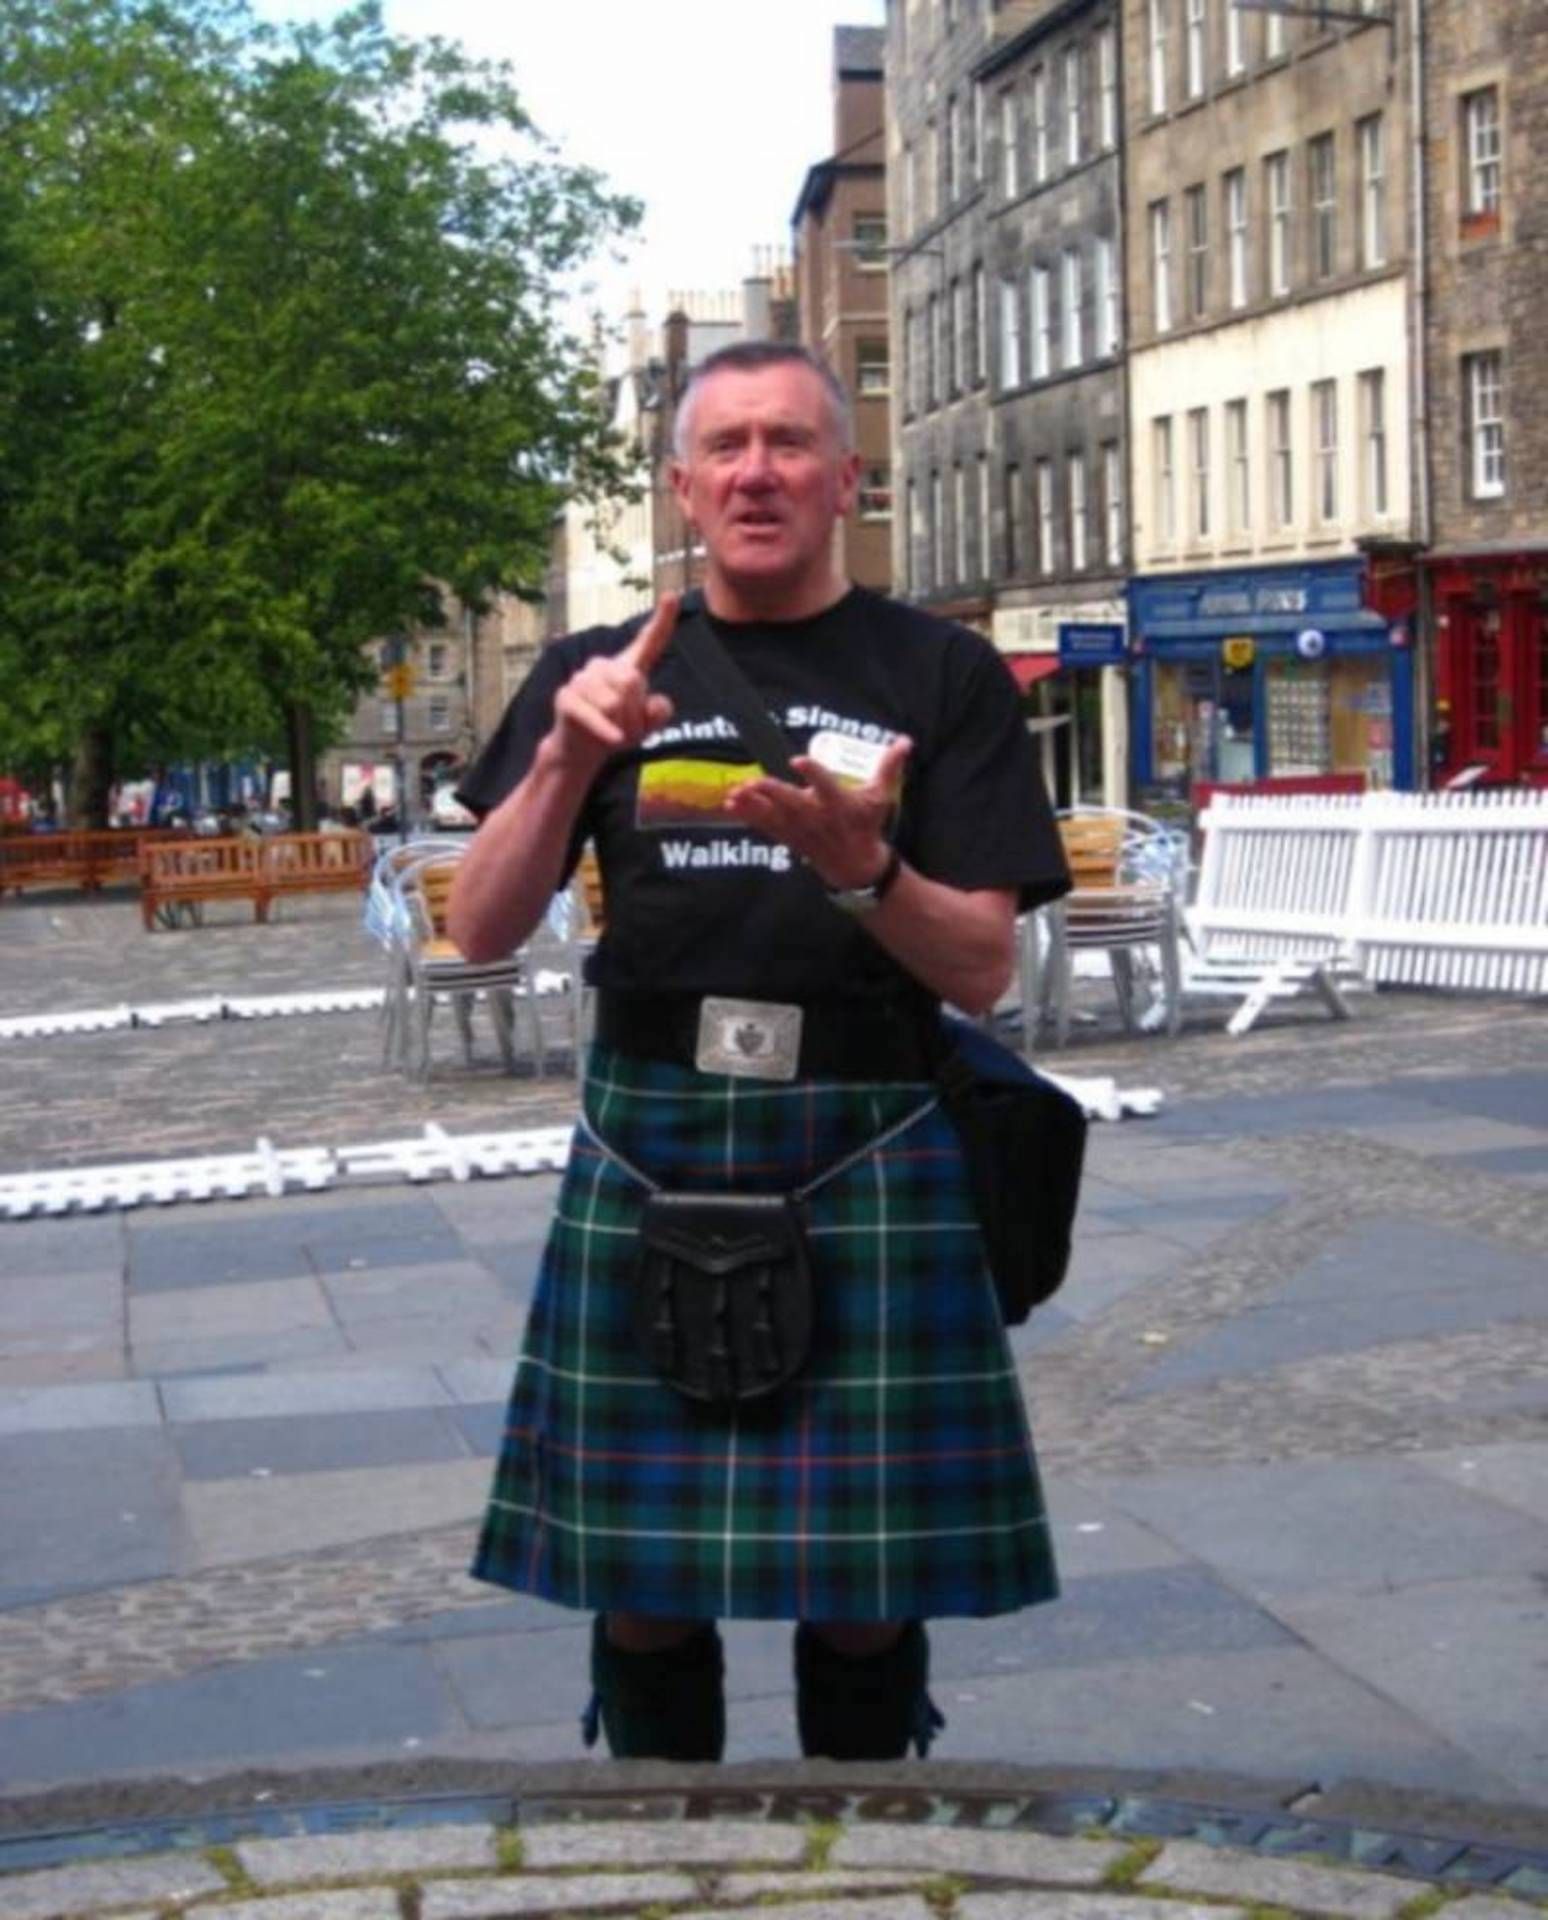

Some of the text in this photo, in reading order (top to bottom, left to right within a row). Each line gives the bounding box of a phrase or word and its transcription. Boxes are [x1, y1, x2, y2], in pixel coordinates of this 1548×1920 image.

[641, 705, 896, 750] Saint Sinner
[660, 839, 791, 871] Walking
